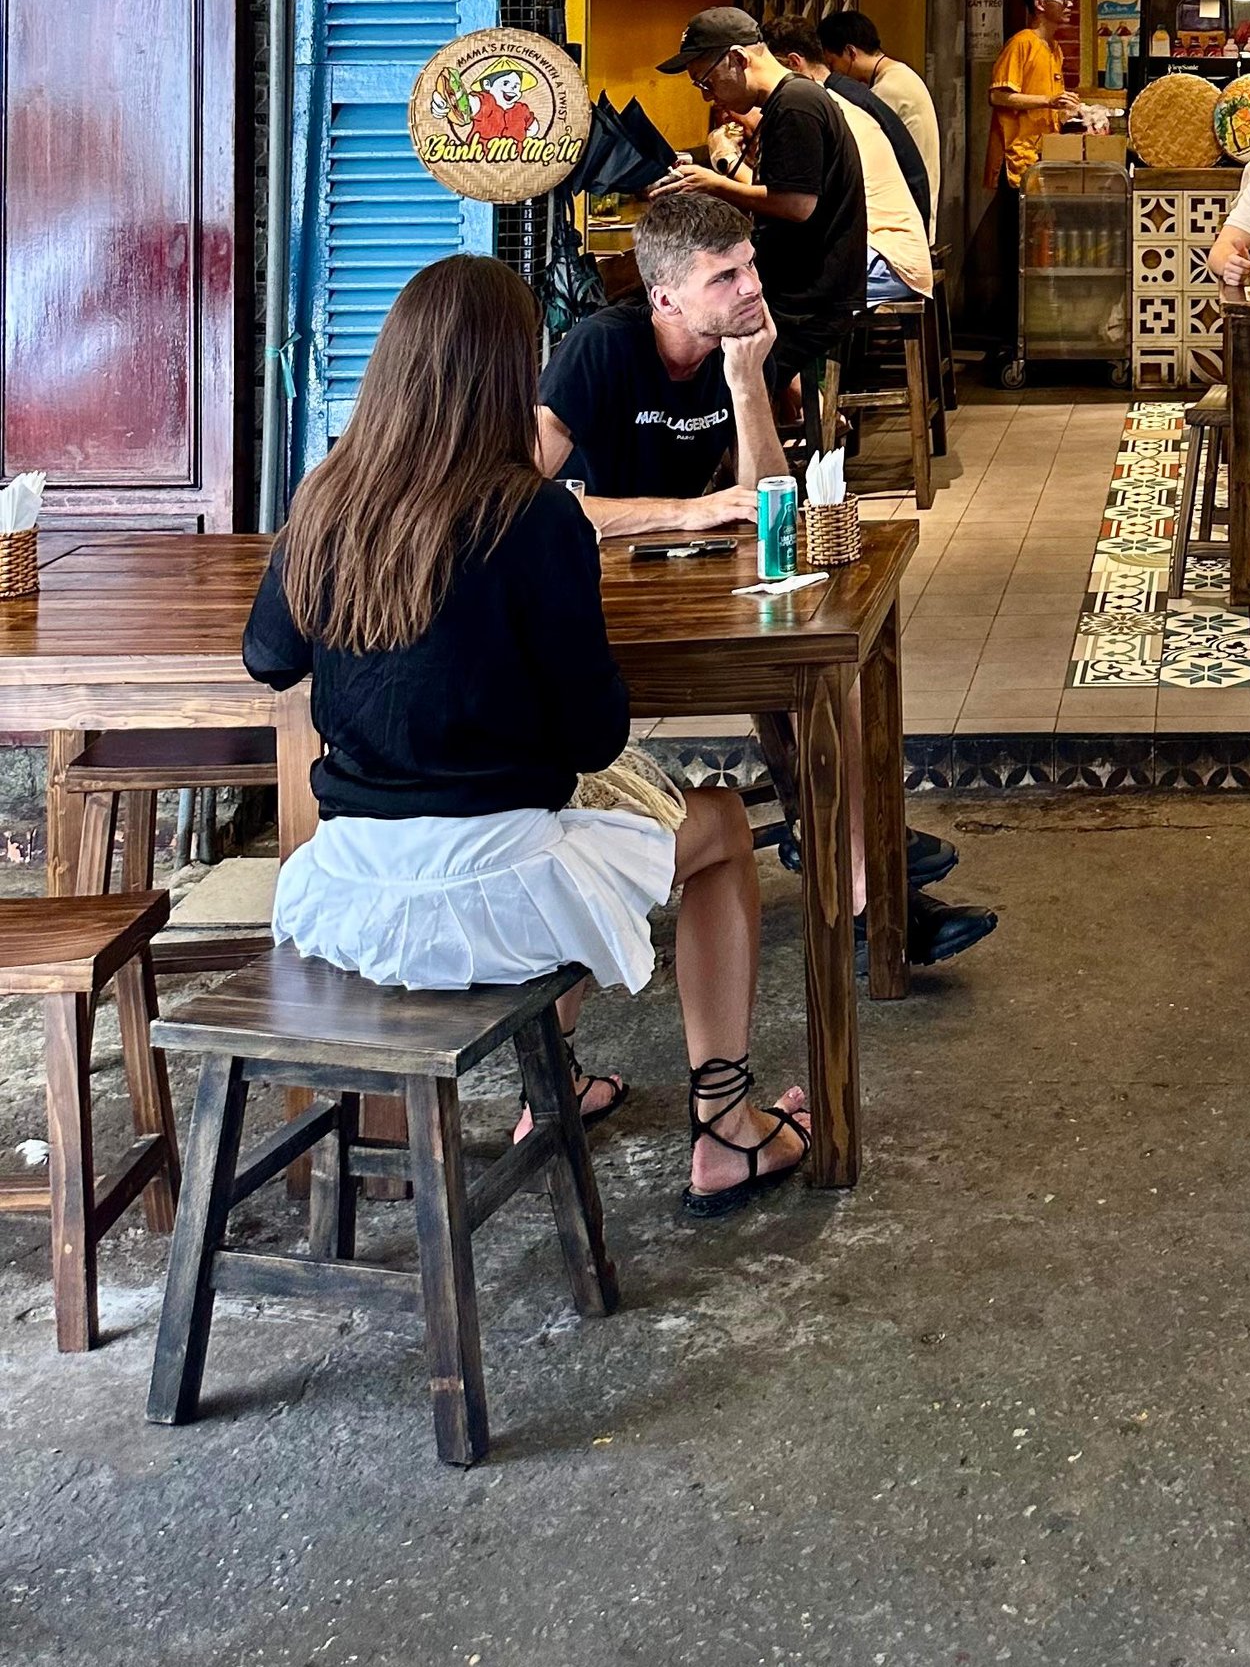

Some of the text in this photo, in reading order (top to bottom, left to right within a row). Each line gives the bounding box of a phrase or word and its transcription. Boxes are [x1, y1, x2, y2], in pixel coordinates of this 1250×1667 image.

[456, 43, 497, 67] MAMA'S
[500, 44, 541, 61] KITCHEN
[540, 57, 560, 80] WITH
[558, 90, 568, 123] TWIST
[424, 132, 484, 163] Bánh
[520, 136, 556, 166] Mẹ
